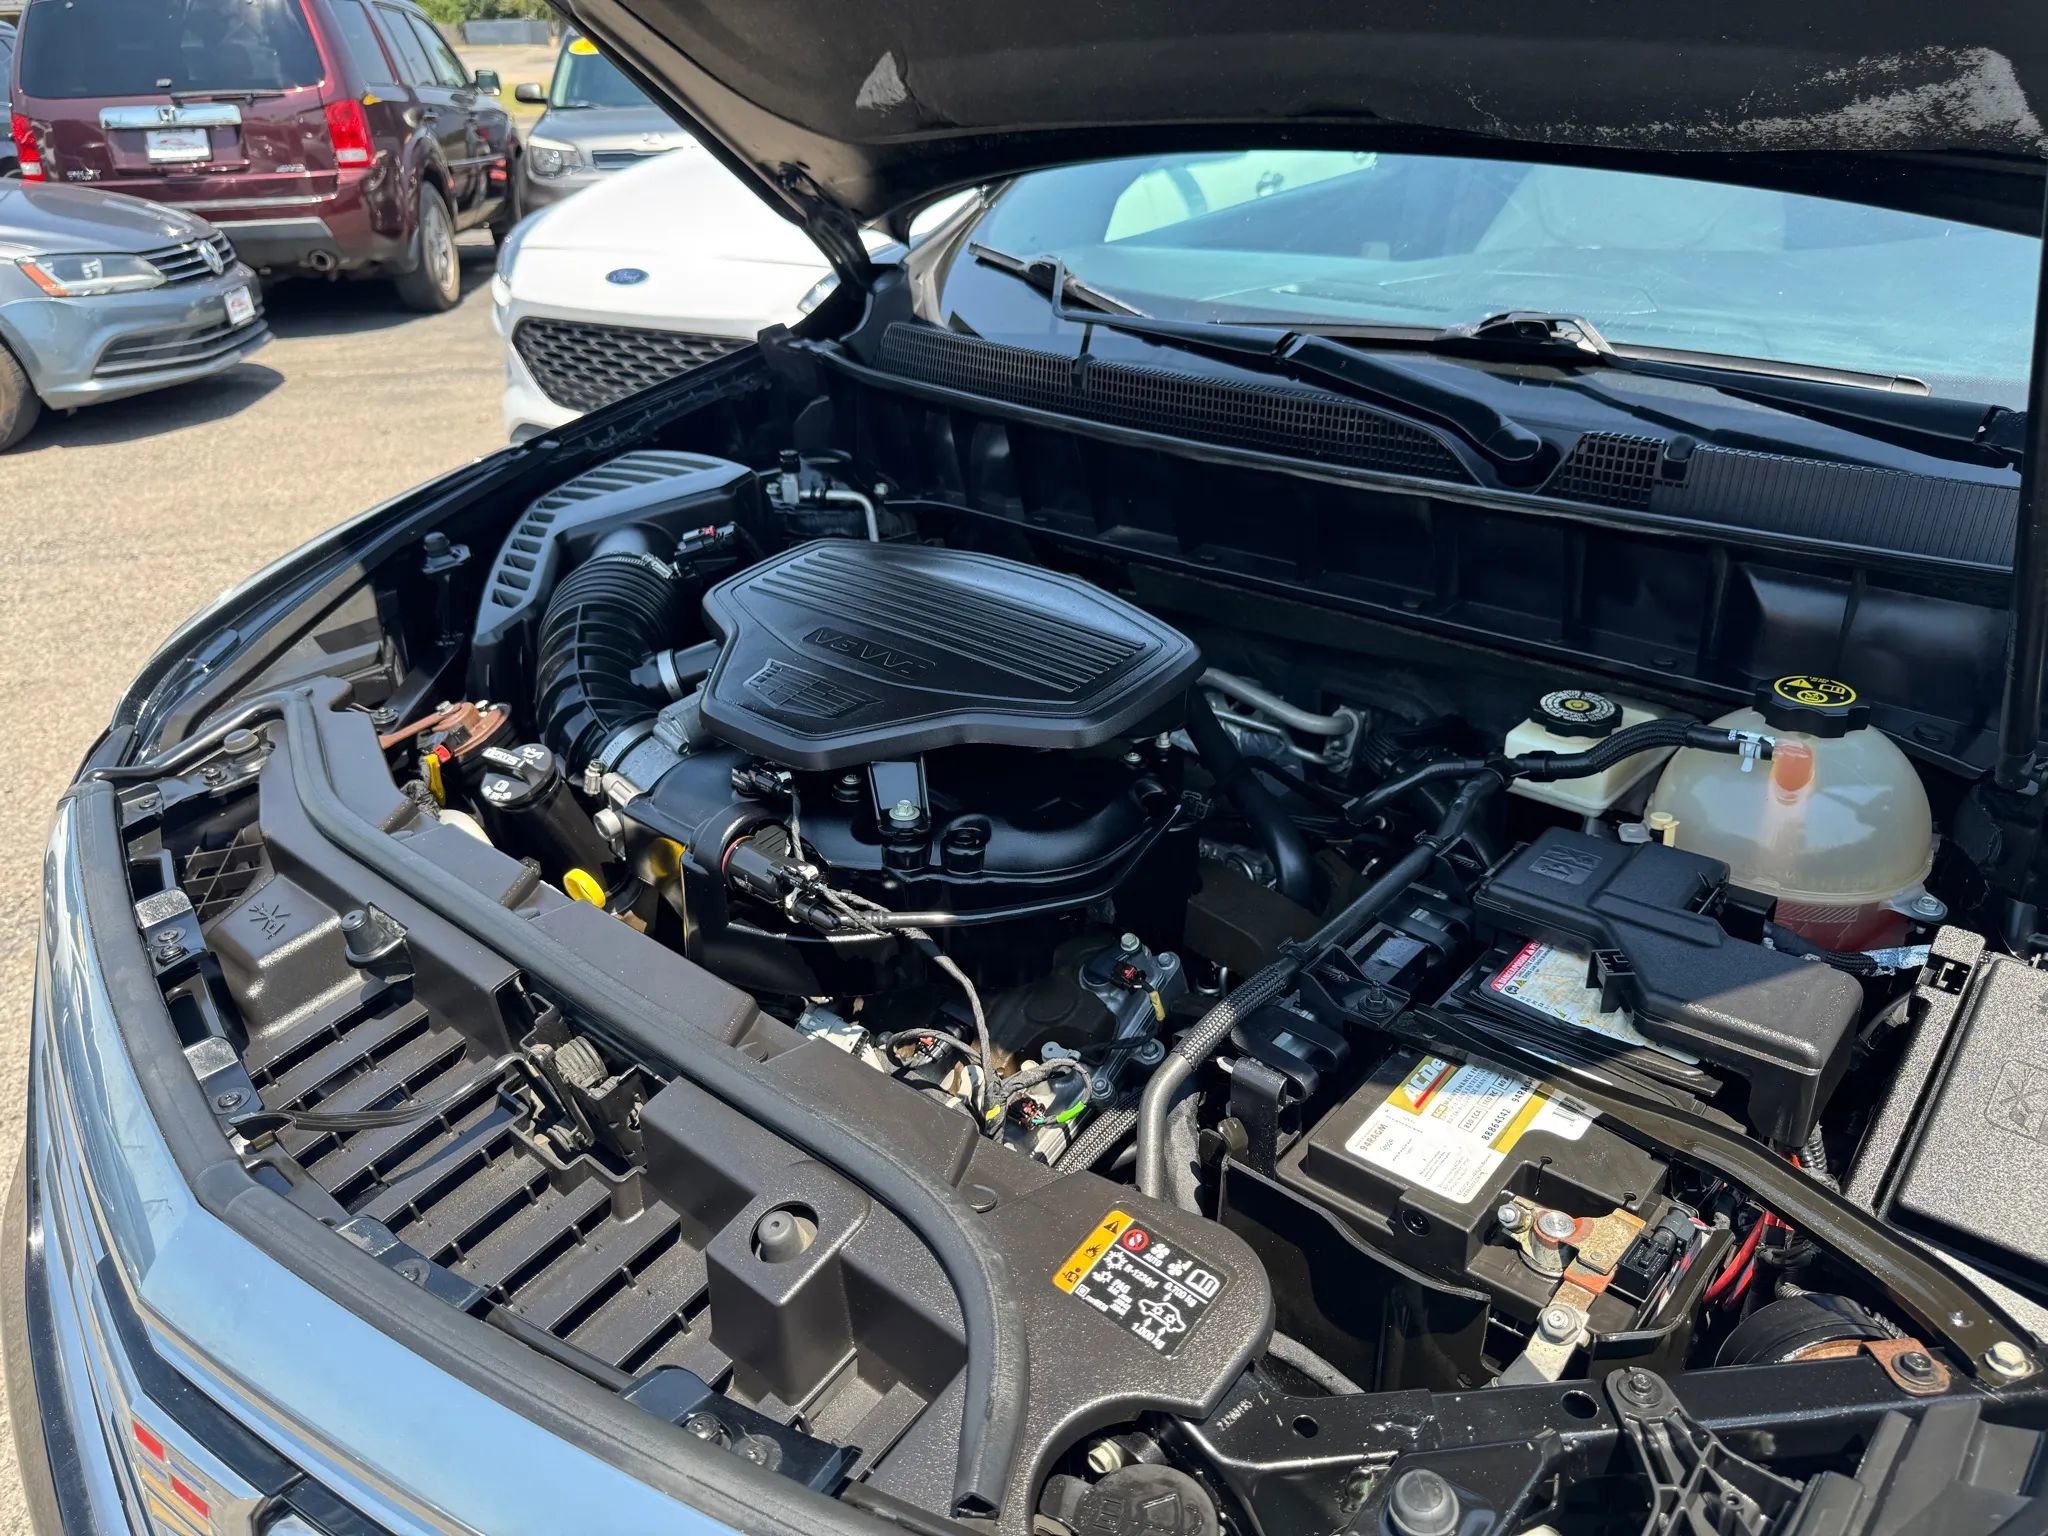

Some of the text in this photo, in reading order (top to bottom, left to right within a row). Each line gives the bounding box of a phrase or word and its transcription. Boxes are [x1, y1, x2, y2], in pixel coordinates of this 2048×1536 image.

[1360, 1123, 1388, 1151] 94RAGM
[1481, 1108, 1512, 1141] 88864542
[1142, 1252, 1164, 1267] AUTO
[1123, 1264, 1159, 1289] R-1234yf
[1163, 1281, 1198, 1308] 0.700 kg
[1131, 1322, 1156, 1342] 1.000
